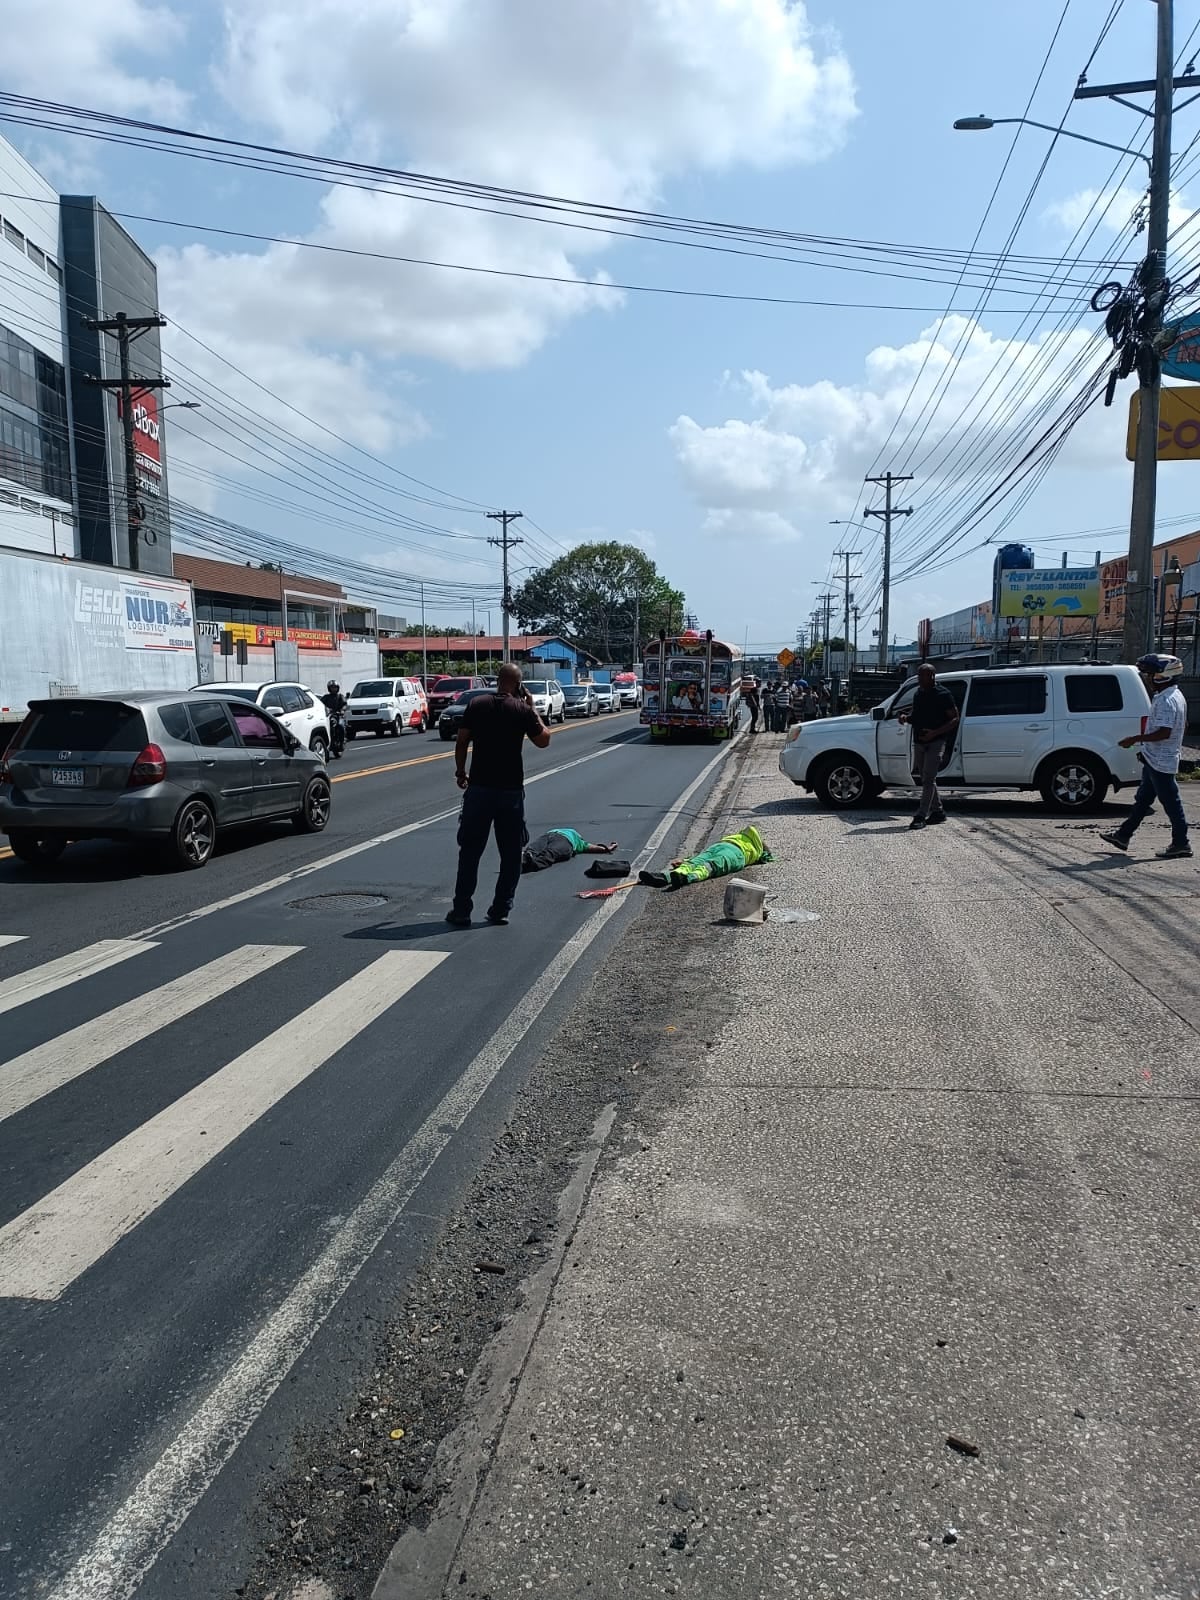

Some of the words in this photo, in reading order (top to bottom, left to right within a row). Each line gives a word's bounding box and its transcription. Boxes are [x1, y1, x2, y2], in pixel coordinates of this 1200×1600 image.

[133, 403, 161, 443] dBox
[1042, 570, 1098, 582] LLANTAS
[125, 596, 169, 625] NUR
[127, 621, 167, 633] LOGISTICS
[199, 622, 218, 641] PIZZA
